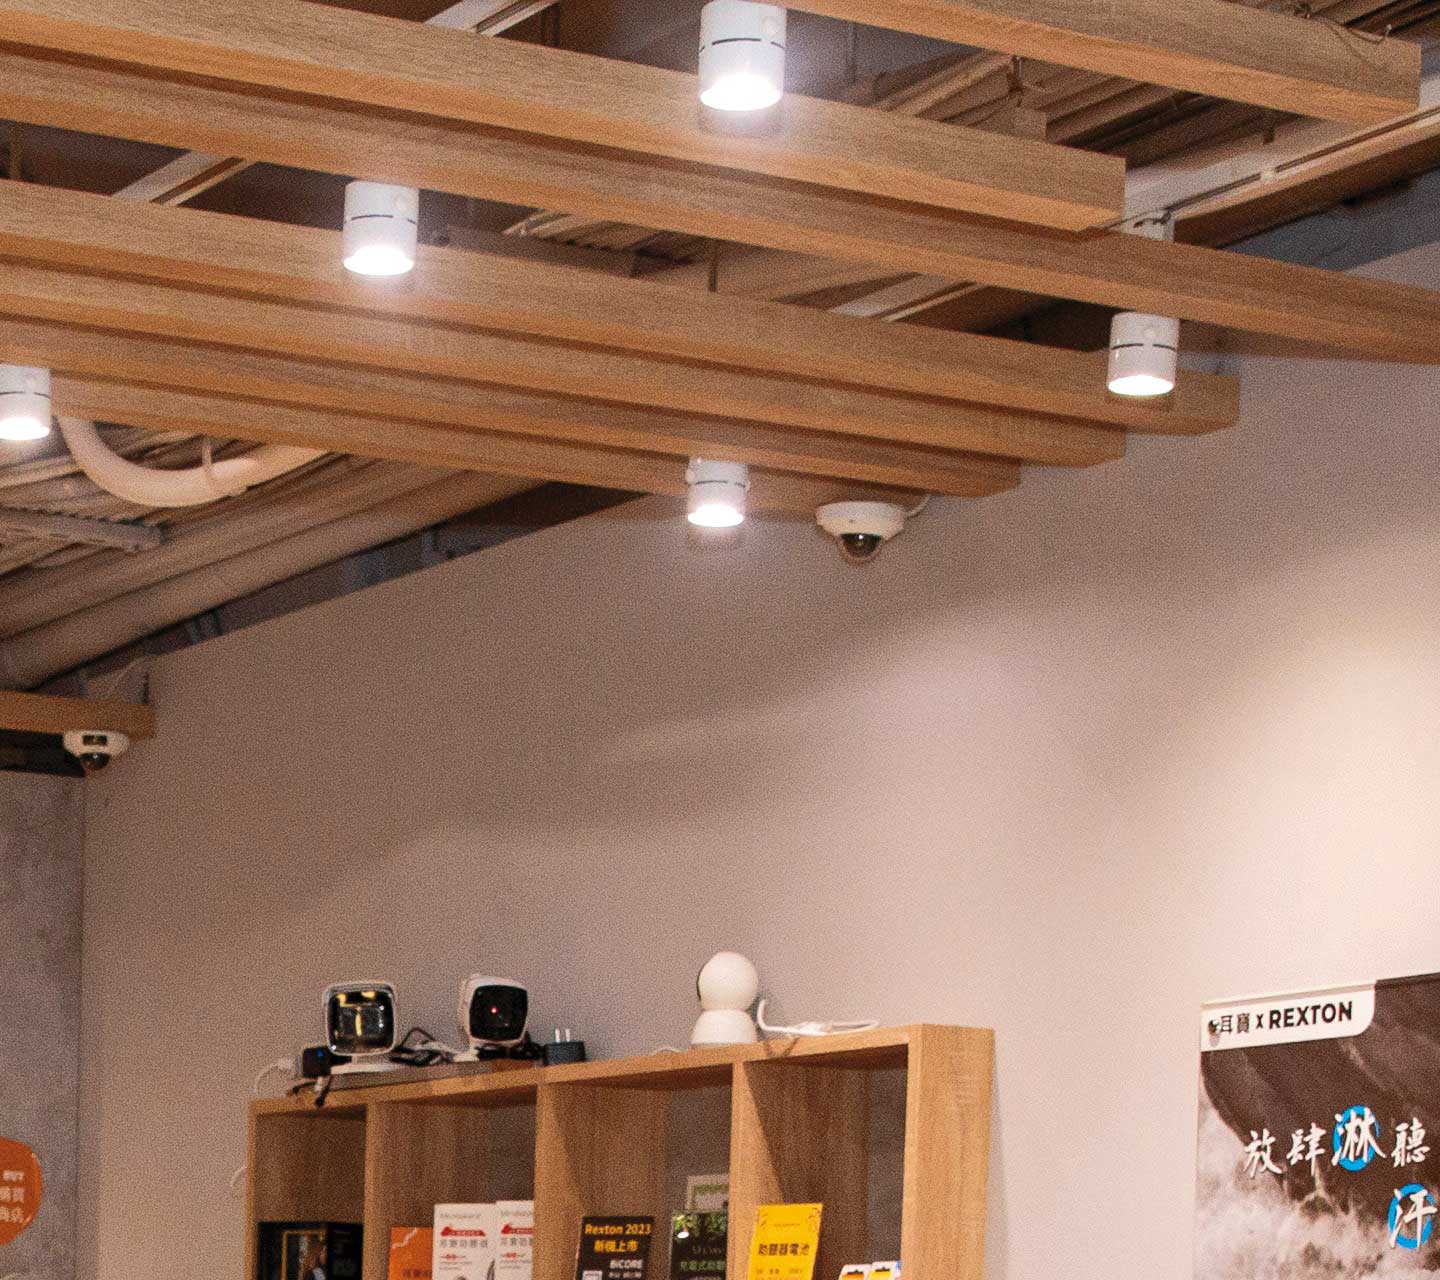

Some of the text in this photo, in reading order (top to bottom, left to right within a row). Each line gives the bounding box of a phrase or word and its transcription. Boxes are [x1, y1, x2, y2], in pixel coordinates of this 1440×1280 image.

[1267, 1000, 1354, 1031] REXTON
[584, 1222, 652, 1237] Rexton 2023
